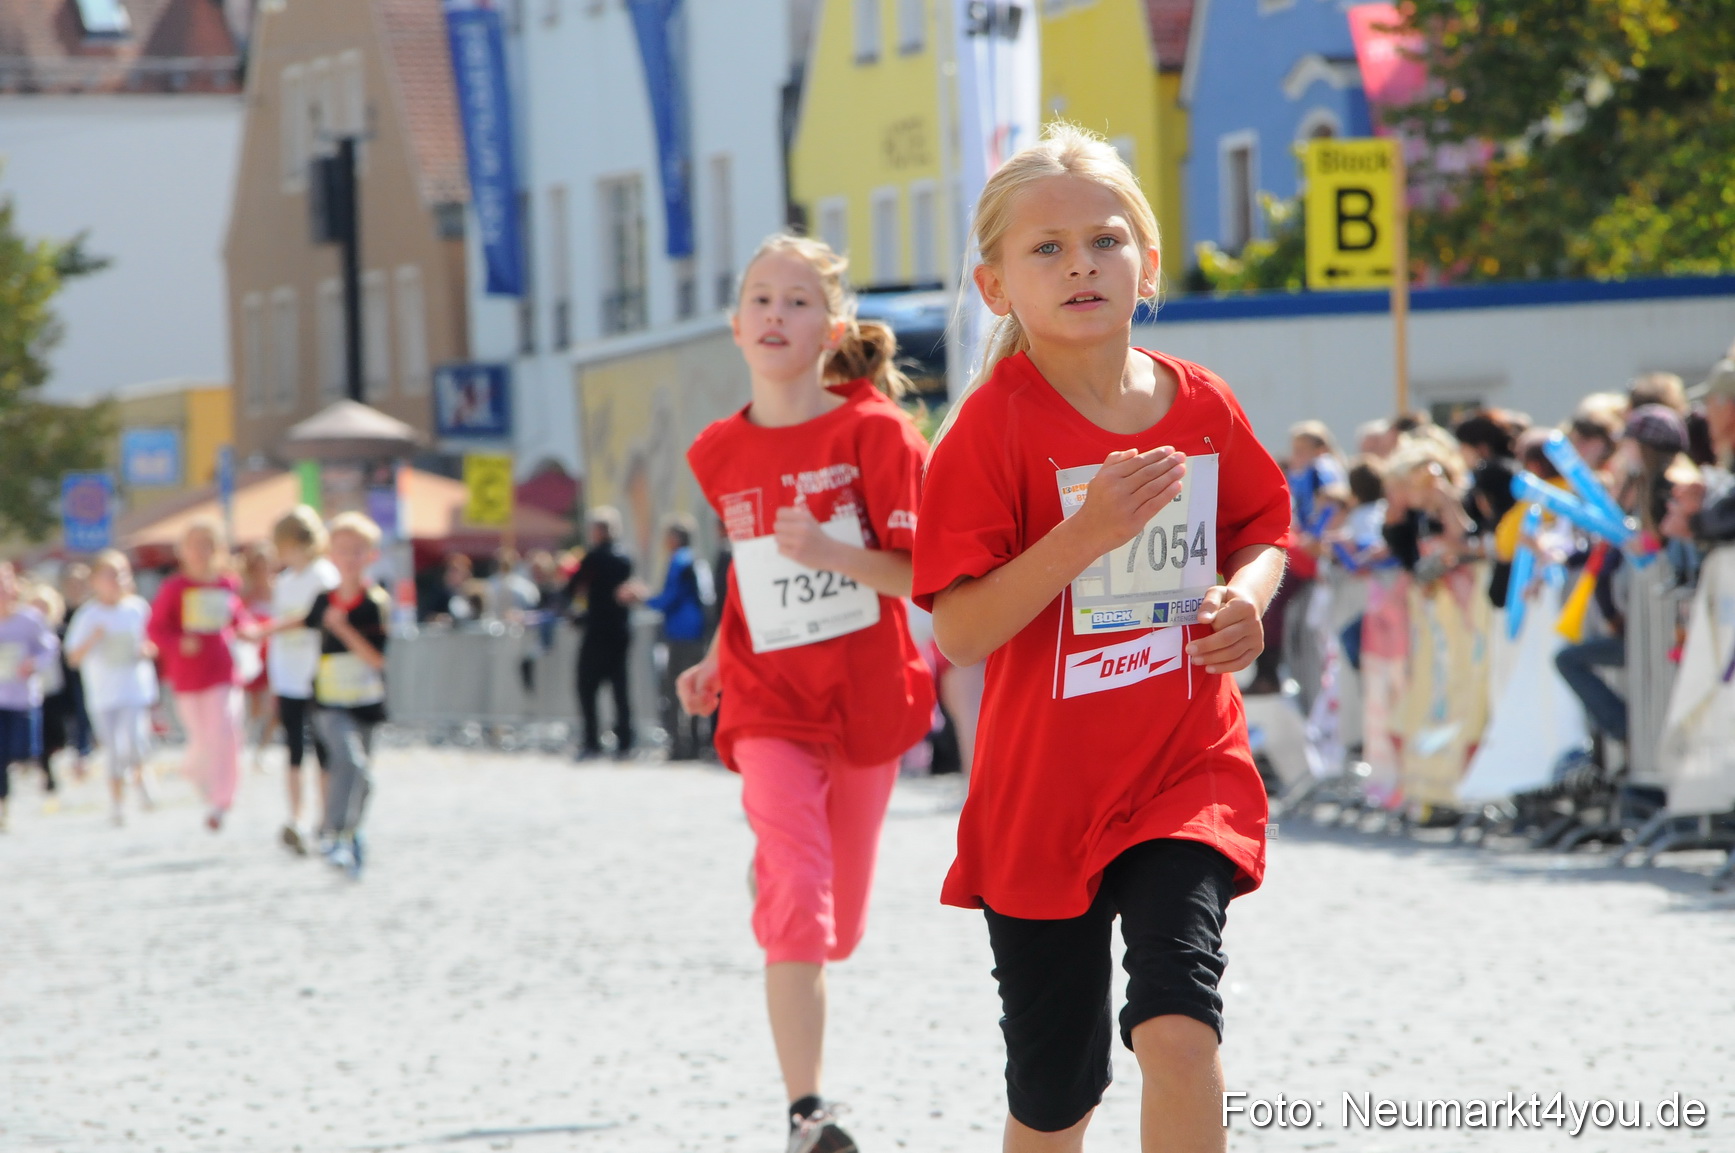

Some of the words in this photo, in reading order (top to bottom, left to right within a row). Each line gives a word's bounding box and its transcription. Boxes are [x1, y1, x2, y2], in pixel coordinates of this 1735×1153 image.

[1336, 187, 1378, 252] B
[1126, 521, 1208, 573] 7054
[1092, 609, 1133, 624] BOCK
[1100, 646, 1151, 679] DEHN
